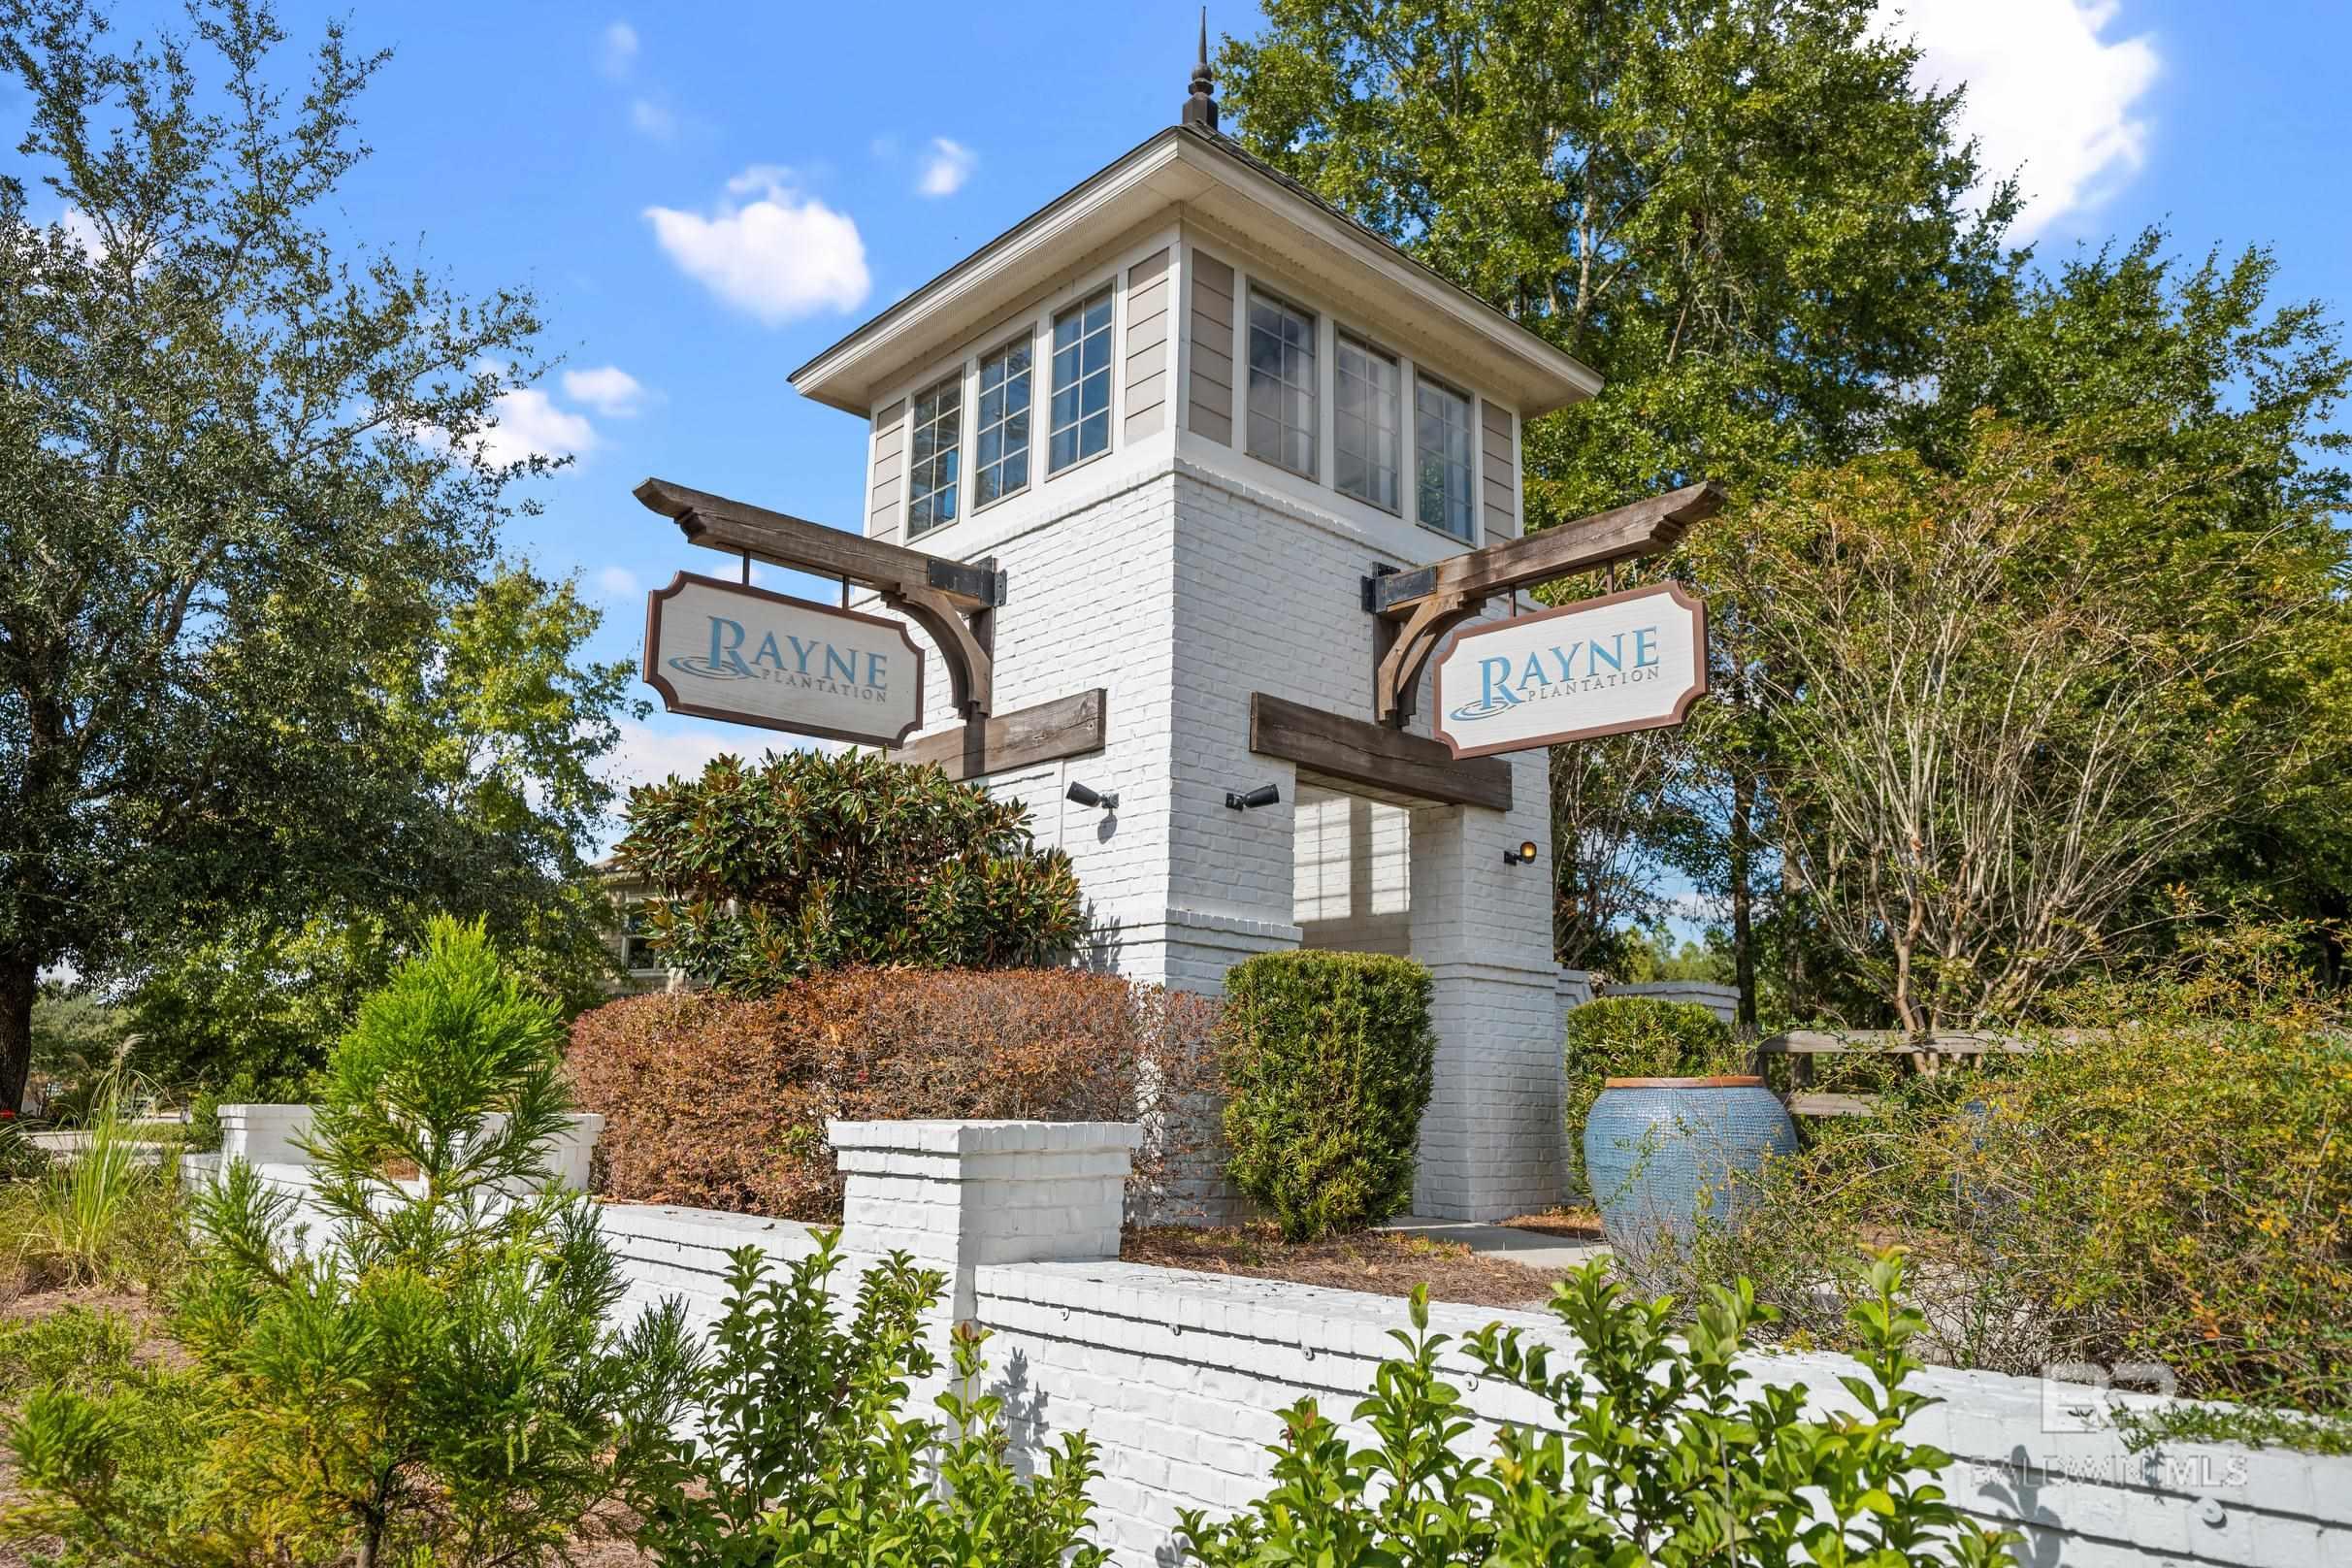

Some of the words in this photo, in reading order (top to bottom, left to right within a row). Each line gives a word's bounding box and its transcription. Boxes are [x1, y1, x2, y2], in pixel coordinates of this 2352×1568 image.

[707, 615, 888, 692] RAYNE
[1478, 626, 1660, 710] RAYNE
[762, 668, 887, 703] PLANTATION
[1528, 666, 1660, 702] PLANTATION
